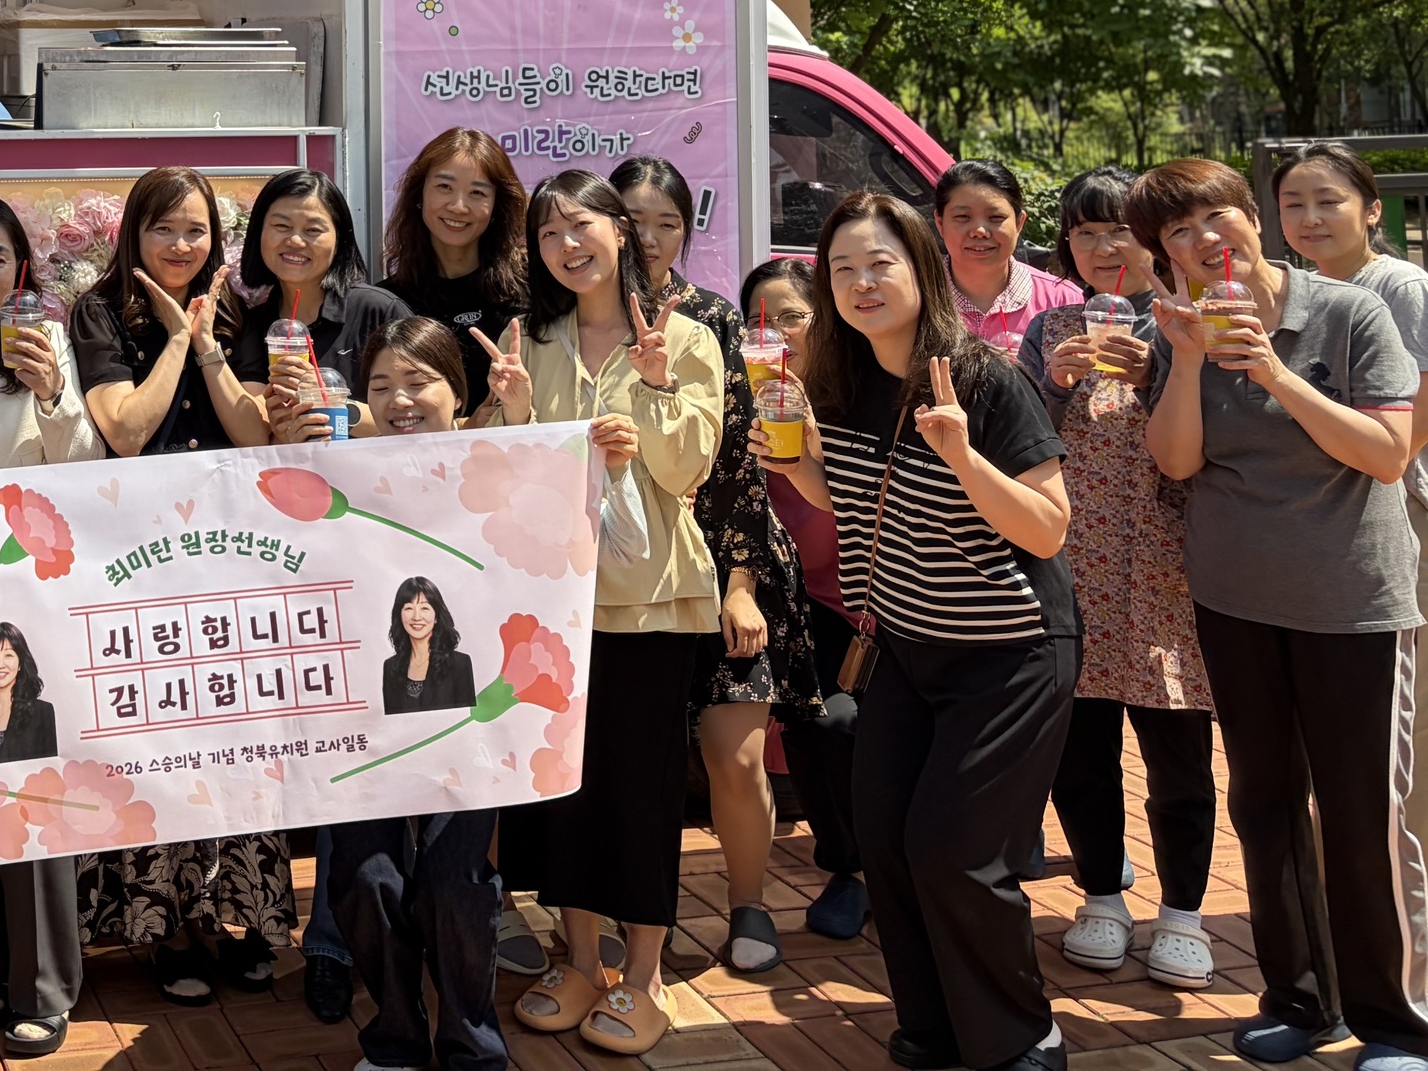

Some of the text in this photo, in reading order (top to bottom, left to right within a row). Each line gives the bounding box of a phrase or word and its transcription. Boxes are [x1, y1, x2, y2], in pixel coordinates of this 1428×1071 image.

[423, 65, 700, 106] 선생님들이 원한다면
[500, 124, 632, 159] 미란이가
[104, 528, 307, 588] 최미란 원장선생님
[101, 605, 329, 660] 사랑합니다
[109, 662, 335, 719] 감사합니다
[105, 733, 370, 778] 2026 스승의날 기념 청북유치원 교사일동
